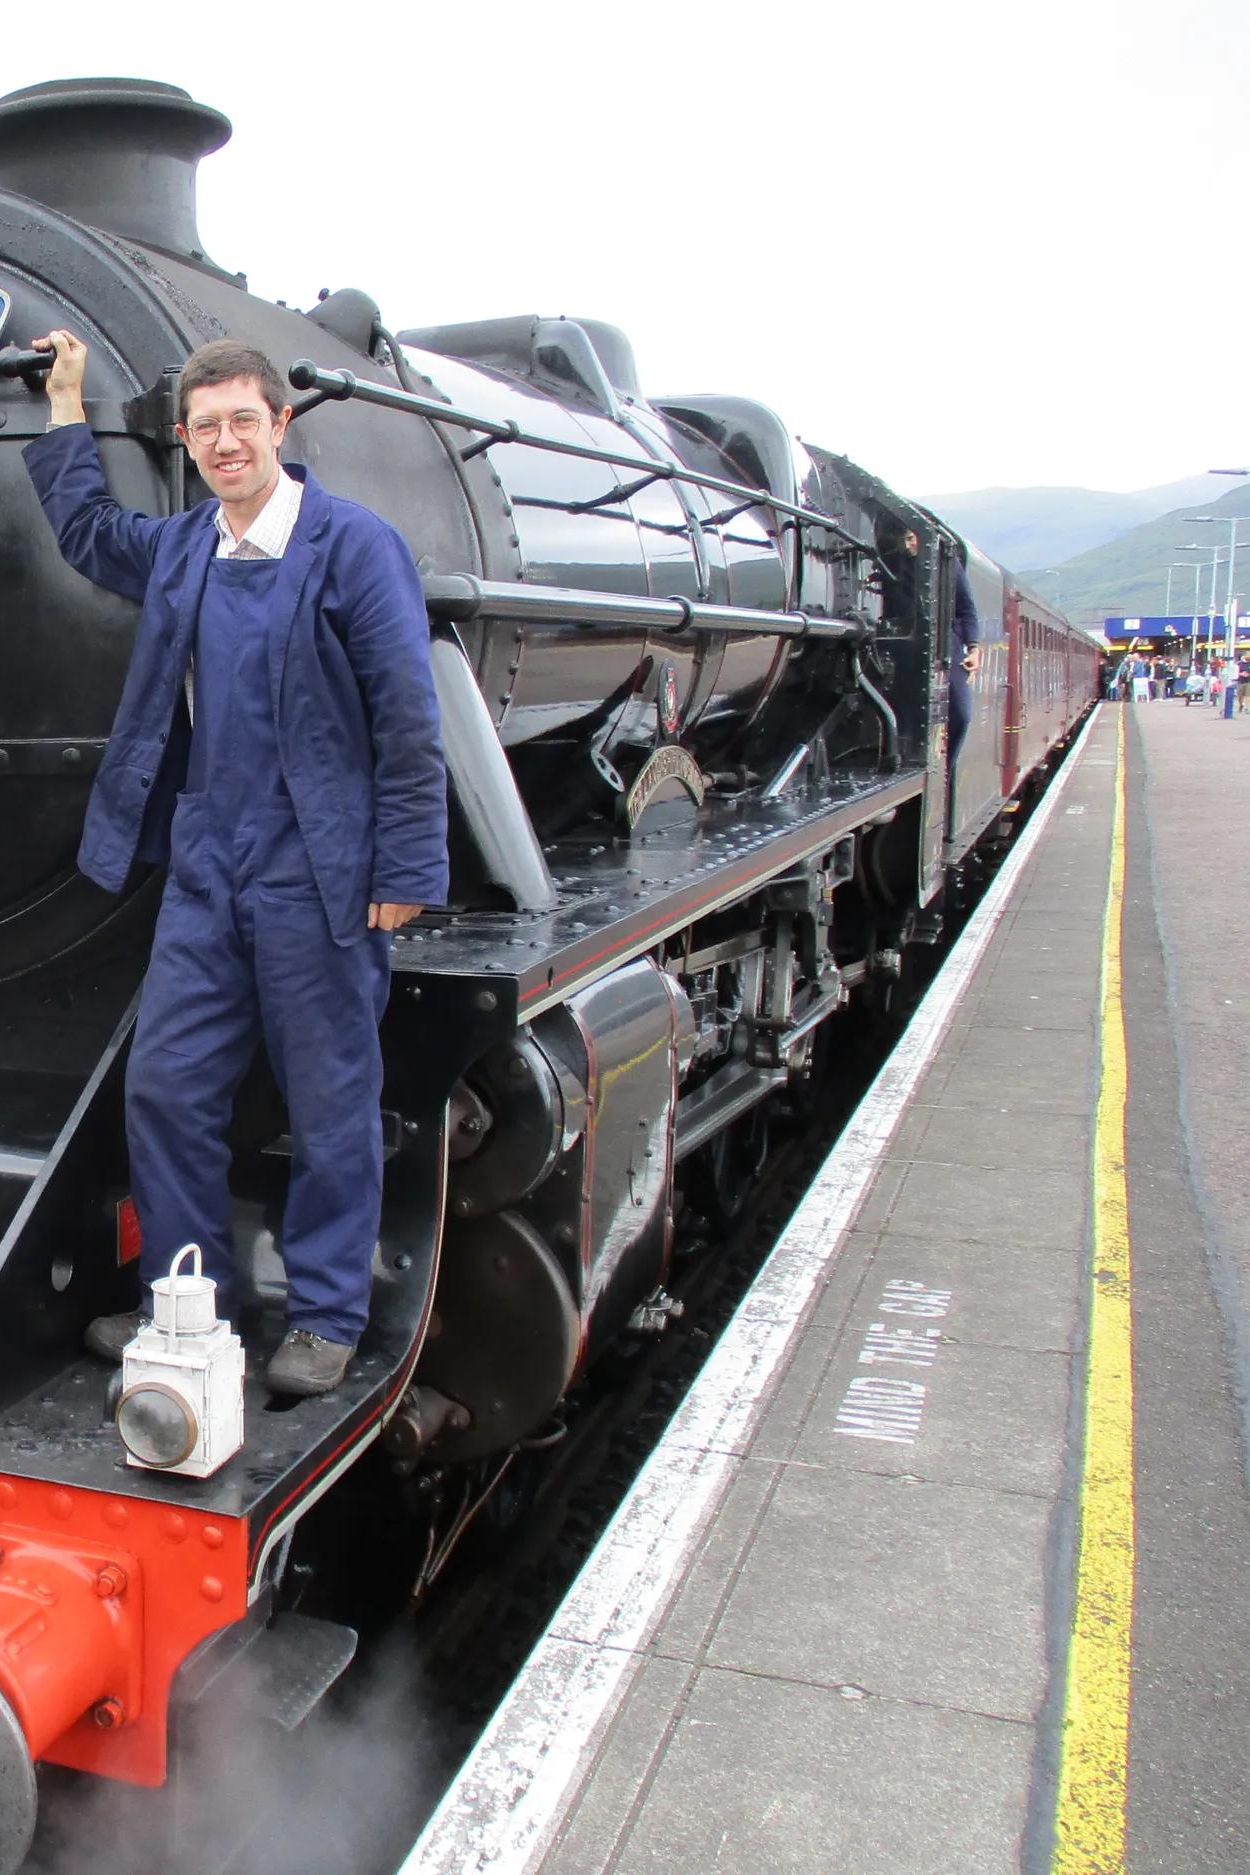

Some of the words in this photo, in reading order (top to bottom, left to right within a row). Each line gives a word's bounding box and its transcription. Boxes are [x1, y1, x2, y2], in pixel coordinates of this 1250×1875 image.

[877, 1279, 953, 1317] GAP
[857, 1323, 942, 1366] THE
[832, 1377, 926, 1444] MIND
